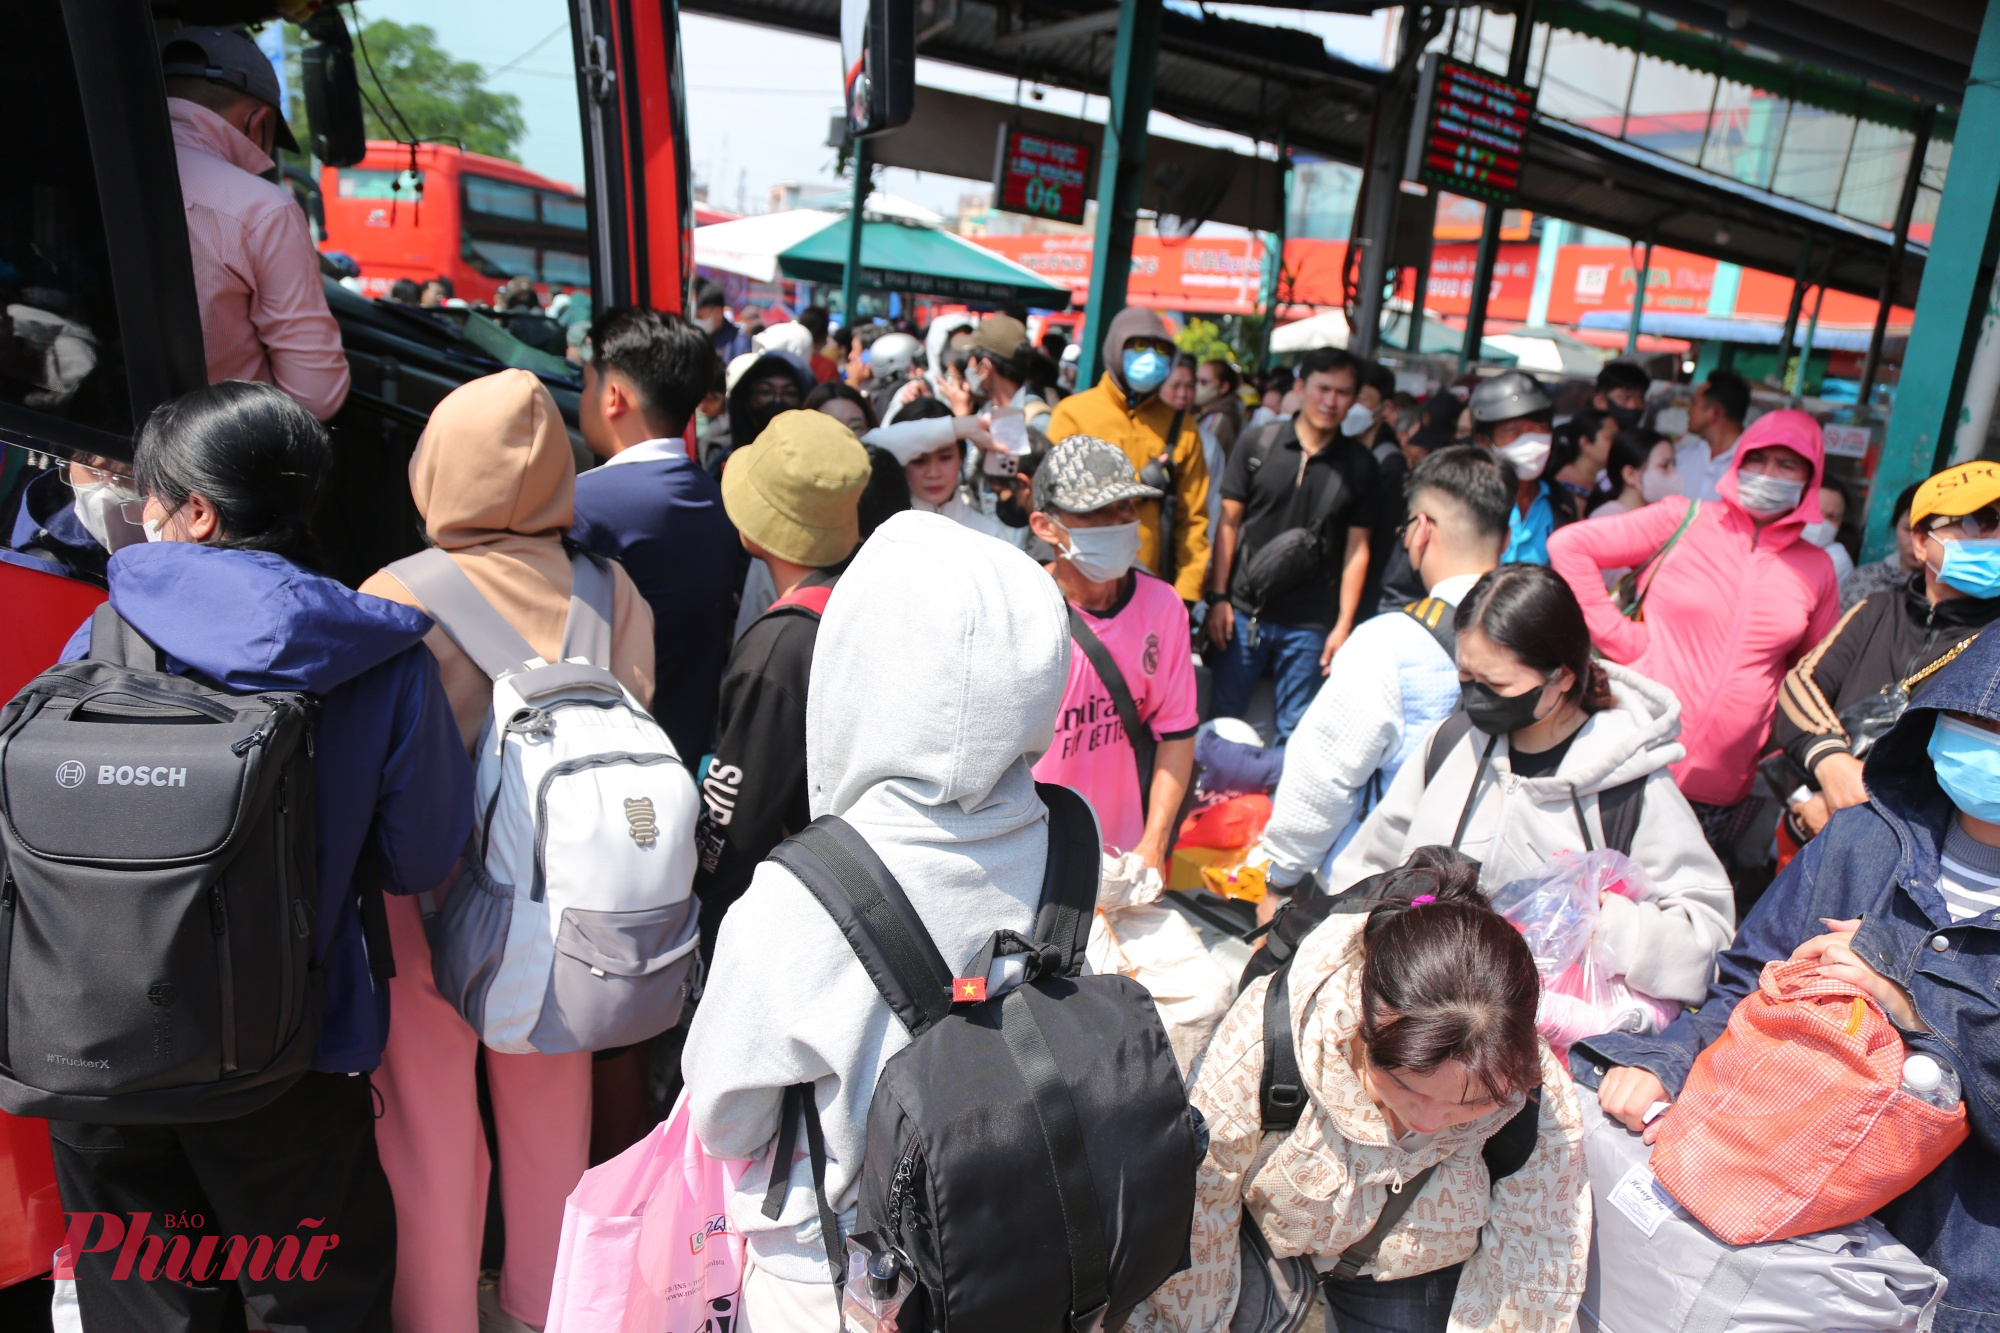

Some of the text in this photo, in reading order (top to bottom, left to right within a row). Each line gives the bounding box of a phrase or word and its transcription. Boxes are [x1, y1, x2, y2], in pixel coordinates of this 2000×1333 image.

[1025, 176, 1062, 215] 06
[1088, 719, 1126, 752] BETTE
[97, 765, 187, 788] BOSCH
[46, 1053, 110, 1069] #TruckerX
